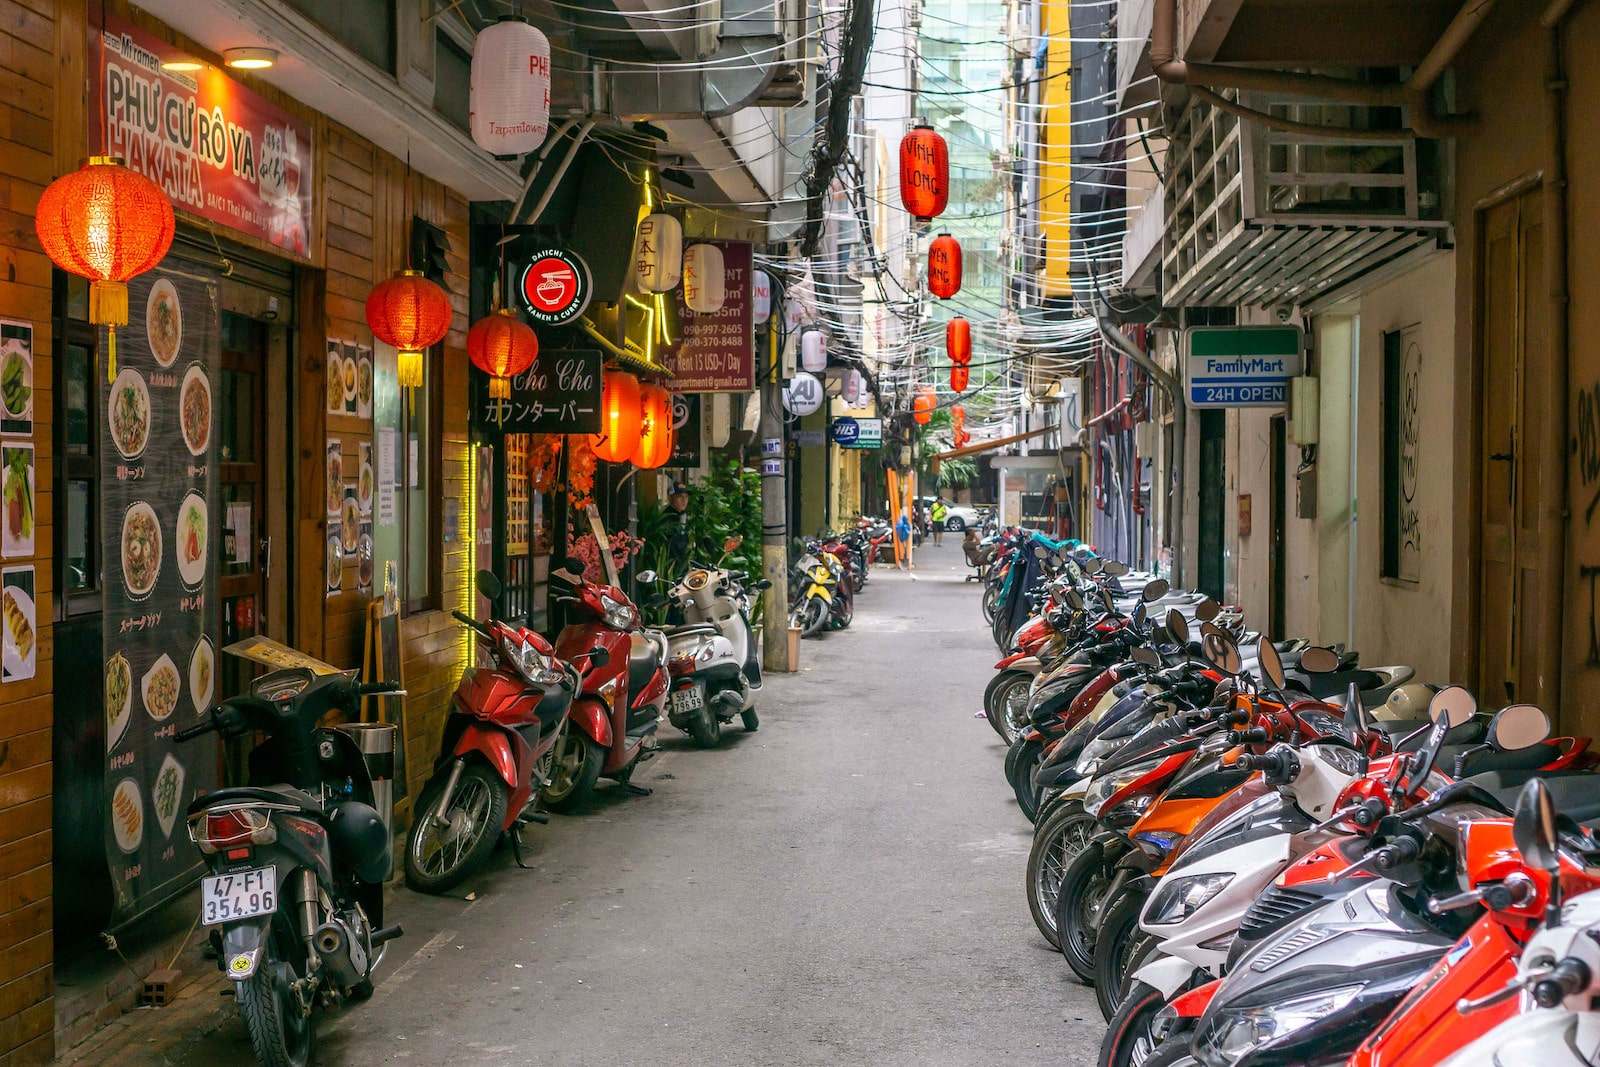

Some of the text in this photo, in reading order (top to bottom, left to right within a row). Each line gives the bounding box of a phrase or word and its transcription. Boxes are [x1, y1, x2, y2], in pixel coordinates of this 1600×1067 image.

[109, 68, 161, 136] PHƯ
[199, 112, 226, 164] RÔ
[229, 127, 255, 179] YA
[108, 121, 204, 209] HAKATA
[906, 167, 940, 195] LONG
[531, 249, 563, 262] DAIICHI
[637, 220, 656, 279] 日本町
[526, 304, 551, 322] RAMEN
[560, 298, 581, 320] CURRY
[555, 358, 594, 392] Cho
[677, 354, 693, 372] Rent
[694, 354, 703, 372] 15
[727, 353, 742, 375] Day
[1207, 358, 1284, 375] FamilyMart
[1206, 387, 1283, 402] 24H OPEN
[484, 399, 594, 425] カウンターバー
[214, 870, 264, 898] 47-F1
[207, 890, 273, 921] 354.96
